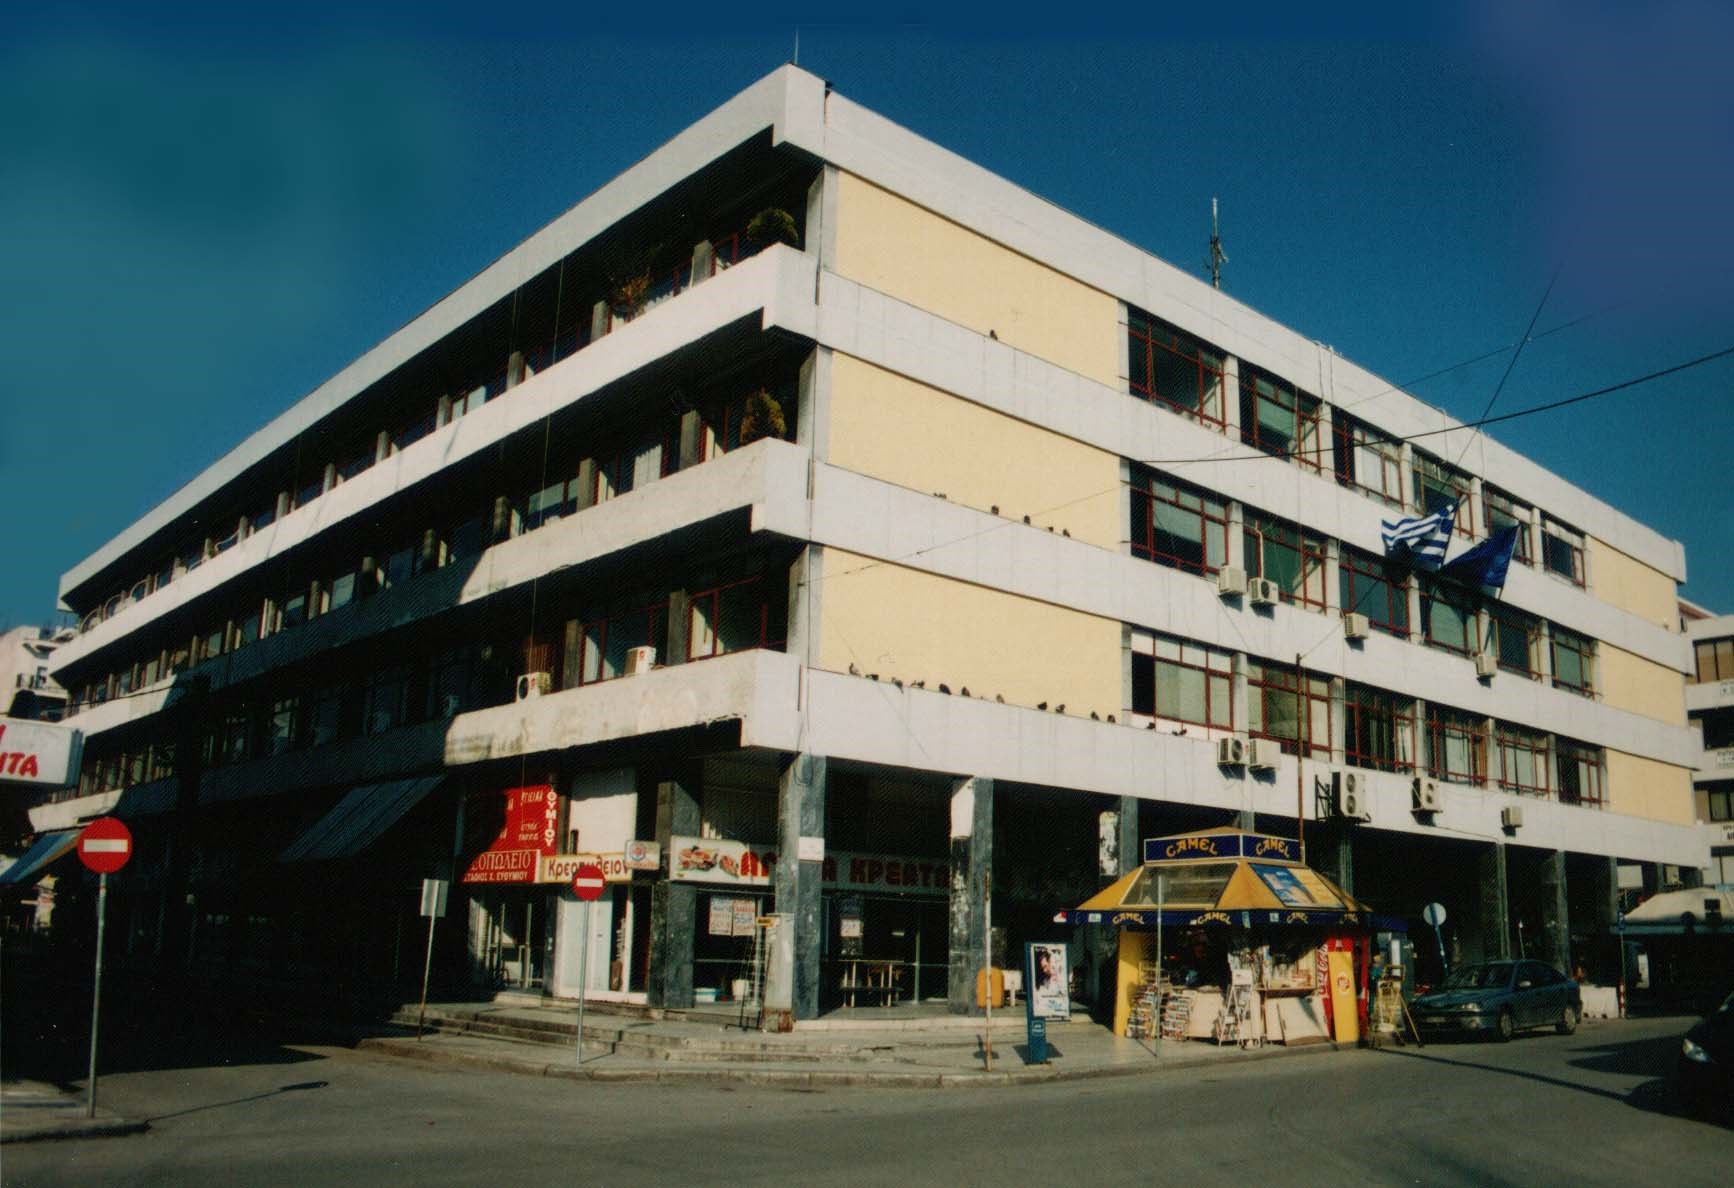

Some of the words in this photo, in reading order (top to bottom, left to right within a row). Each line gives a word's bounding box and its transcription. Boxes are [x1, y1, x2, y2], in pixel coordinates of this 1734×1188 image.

[1165, 838, 1218, 858] CAMEL
[1255, 838, 1291, 858] CAMEL
[1112, 912, 1145, 925] CAMEL
[1197, 912, 1232, 925] CAMEL
[1286, 911, 1309, 924] CAMEL
